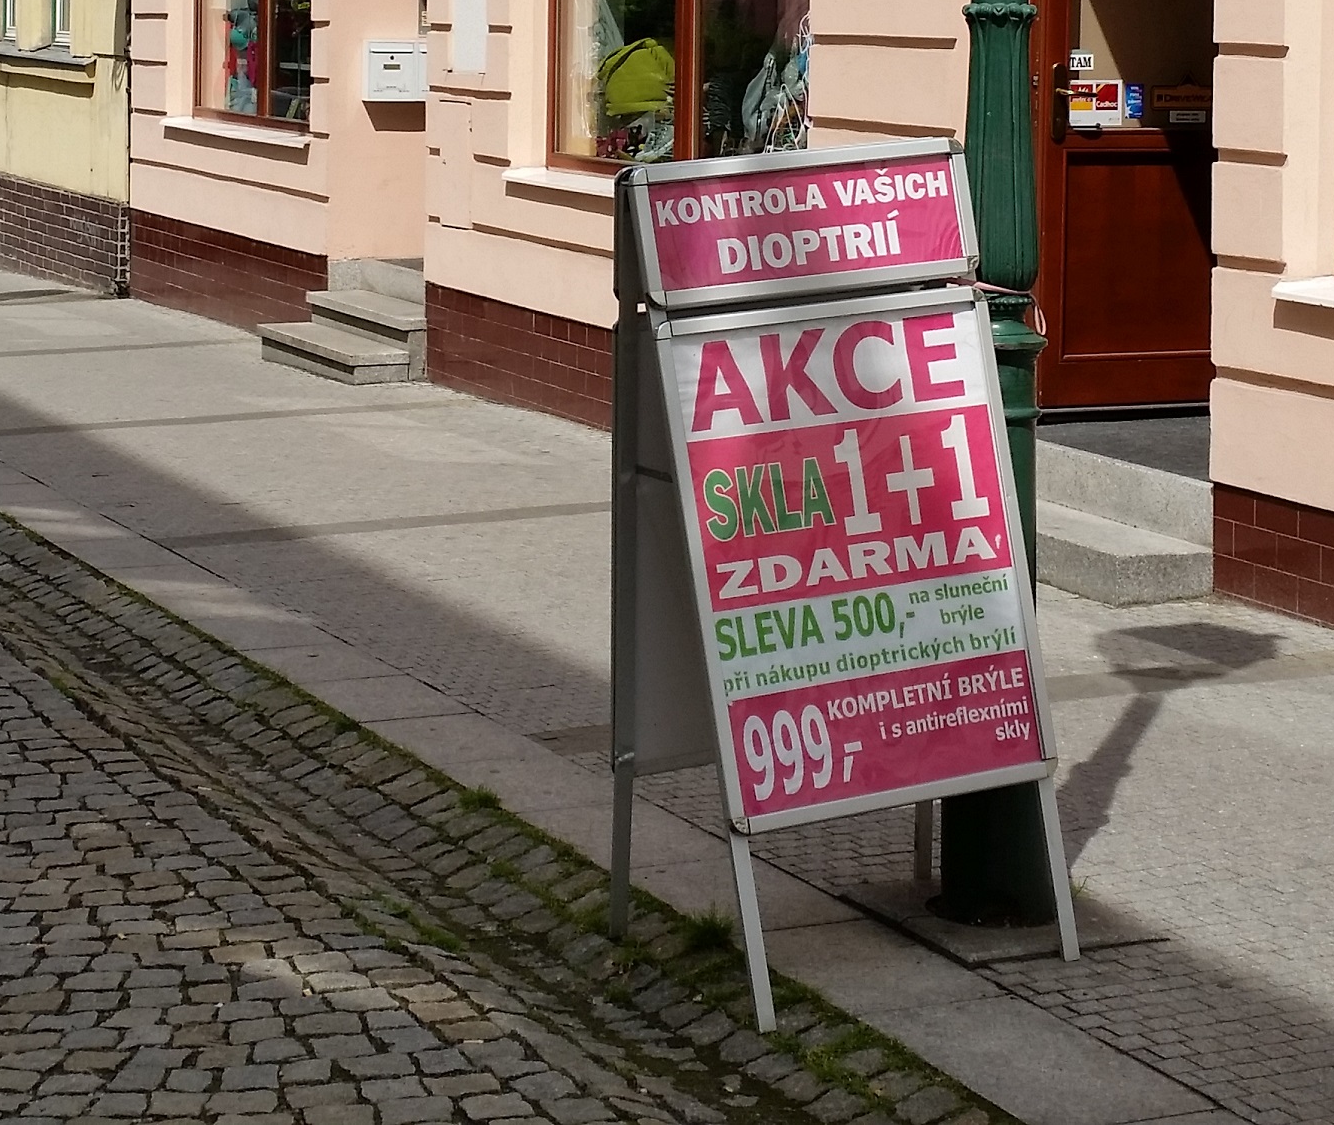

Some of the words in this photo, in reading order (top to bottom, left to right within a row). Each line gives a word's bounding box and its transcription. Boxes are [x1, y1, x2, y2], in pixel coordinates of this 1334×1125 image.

[655, 183, 827, 228] KONTROLA
[832, 168, 949, 209] VAŠICH
[716, 209, 902, 275] DIOPTRIÍ
[690, 312, 966, 432] AKCE
[702, 456, 837, 542] SKLA
[833, 414, 990, 536] 1+1
[715, 525, 996, 600] ZDARMA
[908, 589, 930, 605] na
[934, 573, 1009, 601] sluneční
[715, 603, 825, 662] SLEVA
[939, 604, 986, 626] brýle
[723, 671, 751, 697] při
[755, 660, 831, 688] nákupu
[836, 633, 965, 674] dioptrických
[969, 625, 1017, 652] brýlí
[827, 672, 952, 721] KOMPLETNÍ
[957, 665, 1025, 697] BRÝLE
[879, 721, 888, 740] i
[891, 723, 902, 739] s
[905, 696, 1030, 735] antireflexními
[995, 720, 1031, 743] skly
